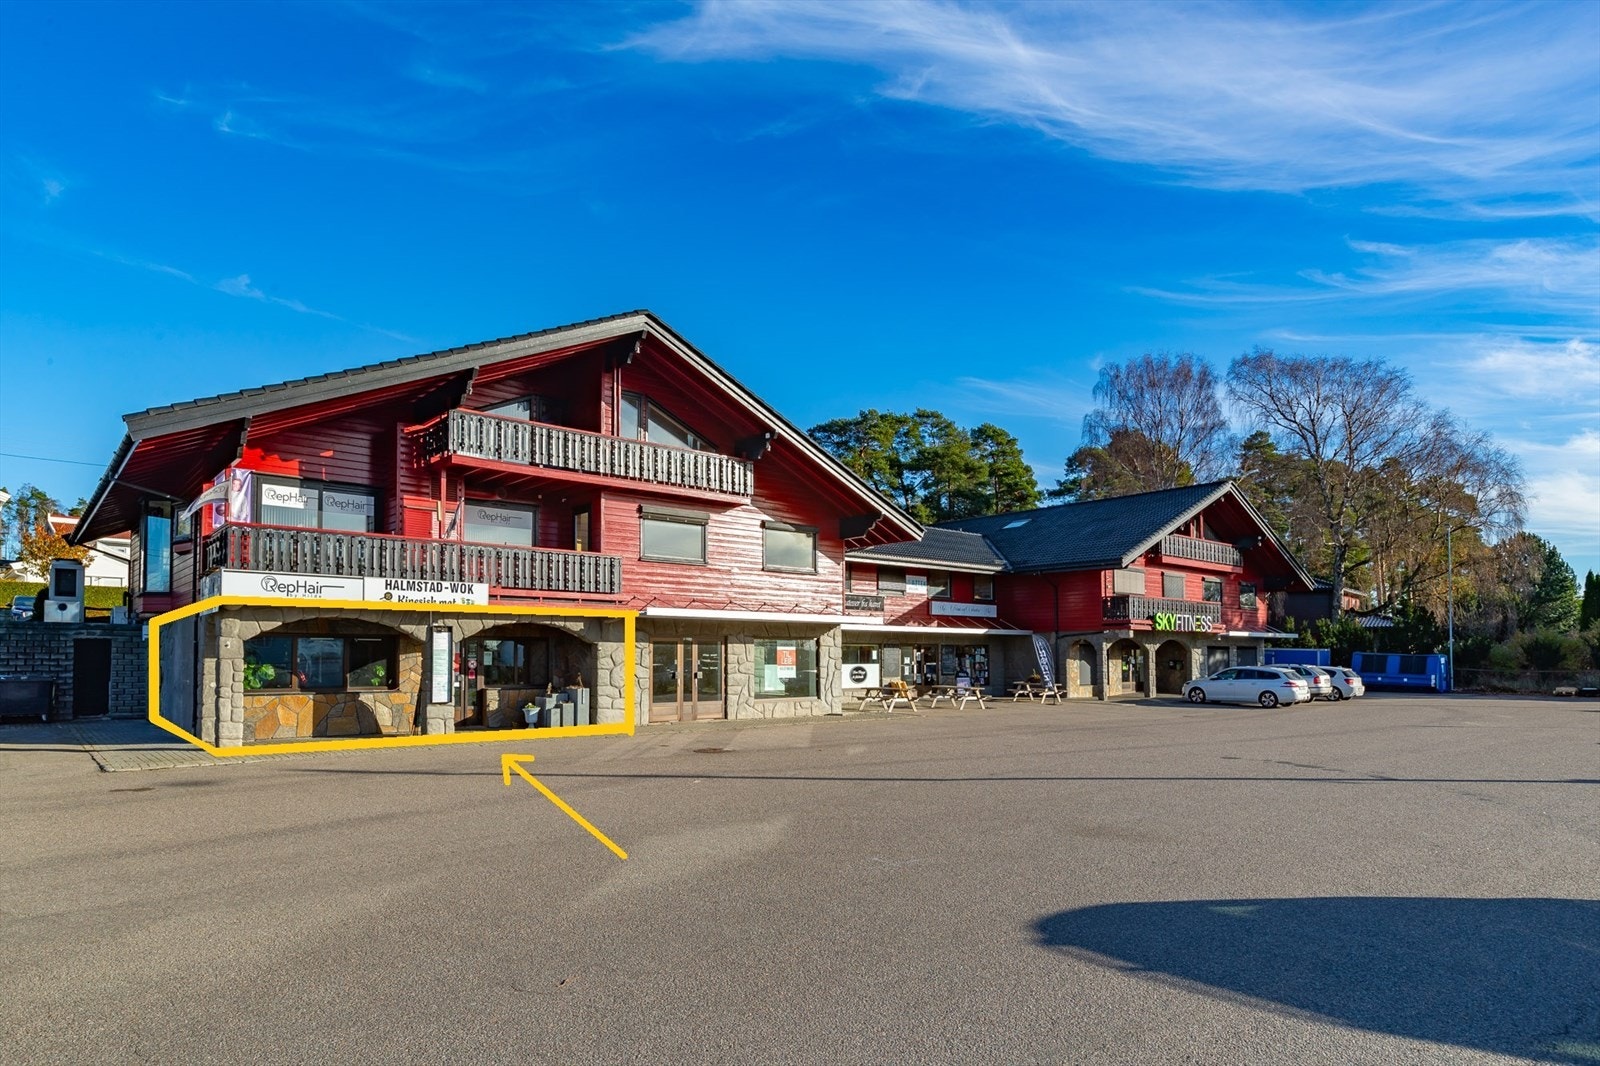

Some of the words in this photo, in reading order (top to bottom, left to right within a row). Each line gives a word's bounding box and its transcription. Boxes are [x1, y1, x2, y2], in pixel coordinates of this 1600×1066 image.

[264, 487, 318, 504] RepHair
[324, 494, 376, 510] RepHair
[477, 508, 522, 523] RepHair
[260, 575, 344, 596] RepHair
[384, 579, 474, 594] HALMSTAD-WOK
[1156, 612, 1212, 632] SKYFITNESS
